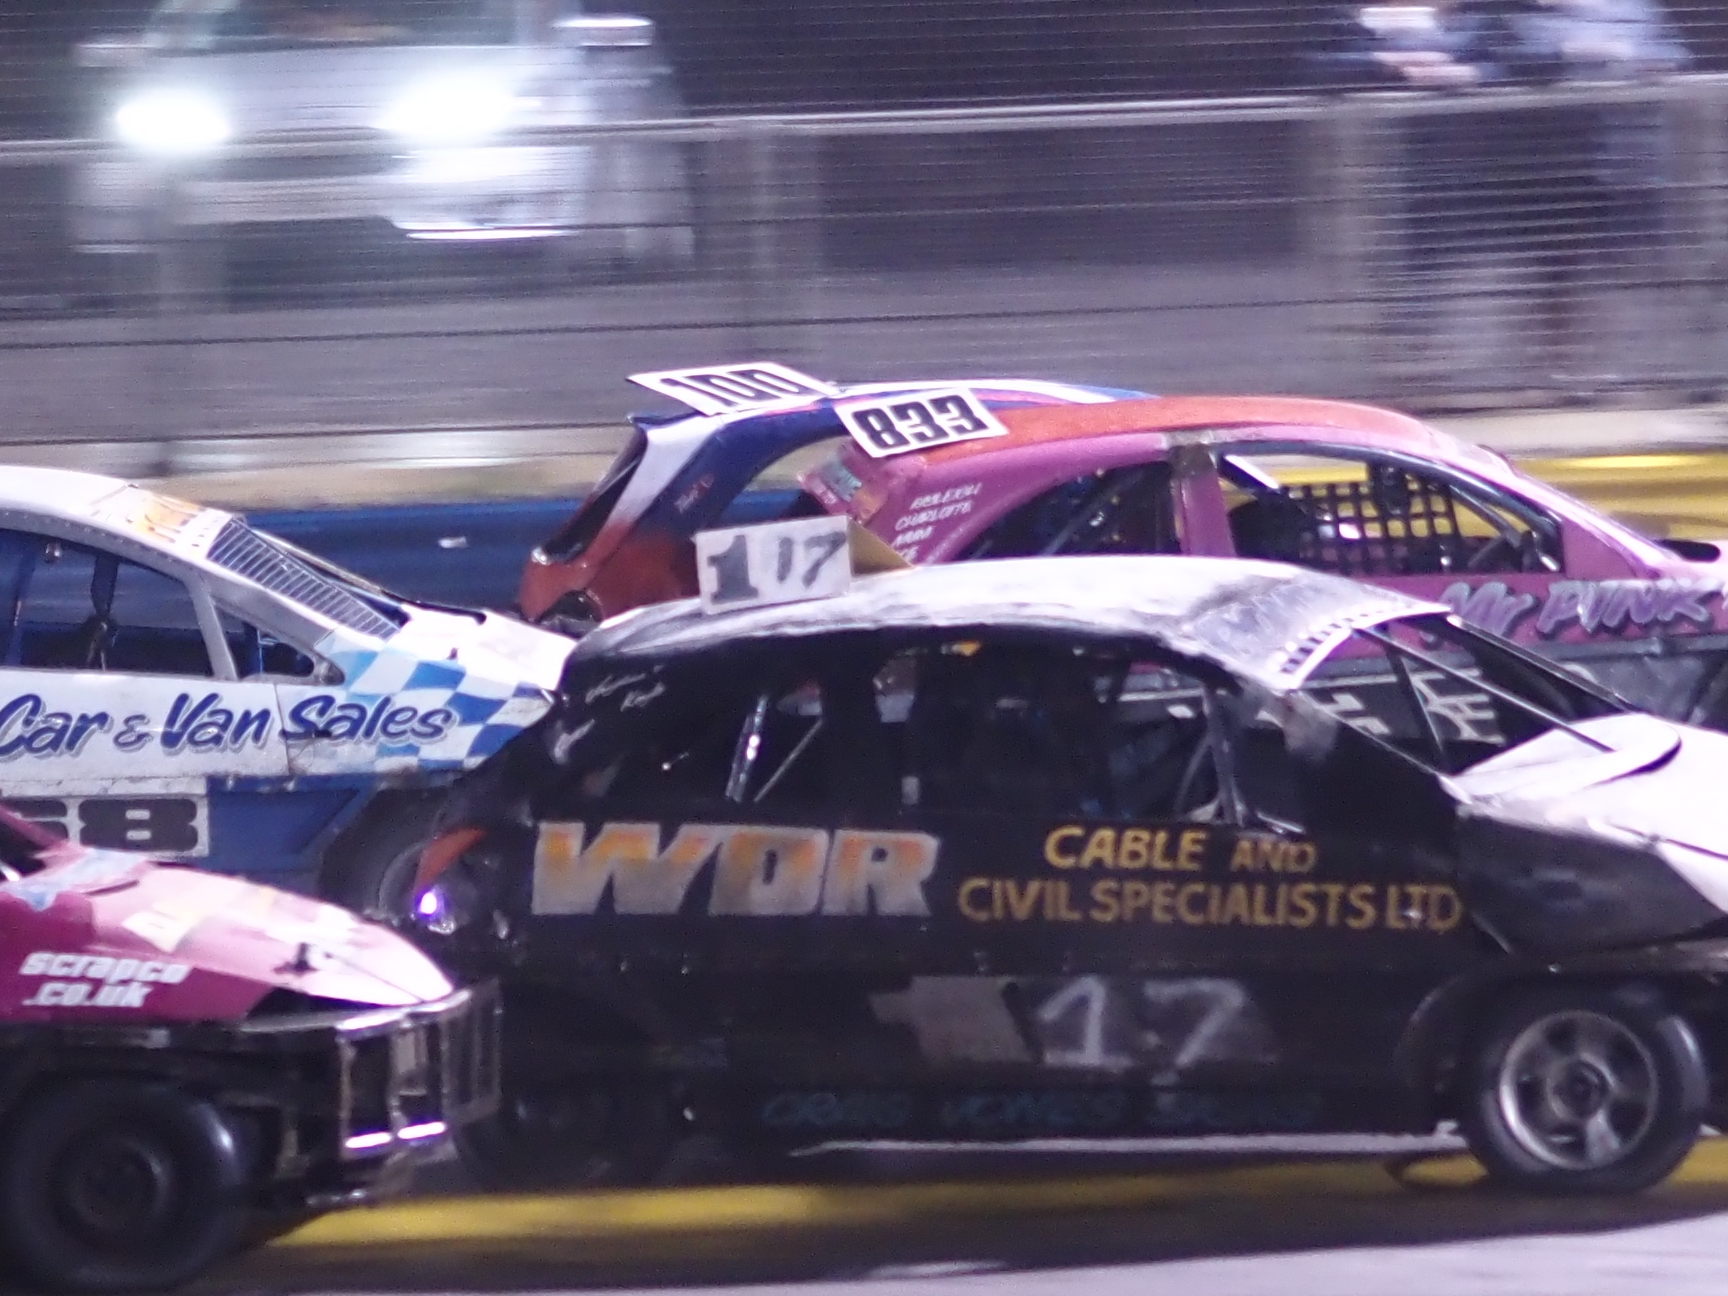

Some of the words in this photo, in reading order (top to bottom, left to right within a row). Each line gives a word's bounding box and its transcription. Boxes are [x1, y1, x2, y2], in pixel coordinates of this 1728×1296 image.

[660, 368, 812, 408] 100
[852, 394, 990, 450] 833
[112, 713, 158, 752] &
[154, 690, 273, 752] Van
[275, 694, 460, 751] Sales
[1043, 825, 1210, 872] CABLE
[1229, 836, 1318, 875] AND
[958, 876, 1081, 923] CIVIL
[1088, 878, 1376, 930] SPECIALISTS
[1385, 885, 1466, 932] LTD
[1038, 975, 1246, 1071] 17
